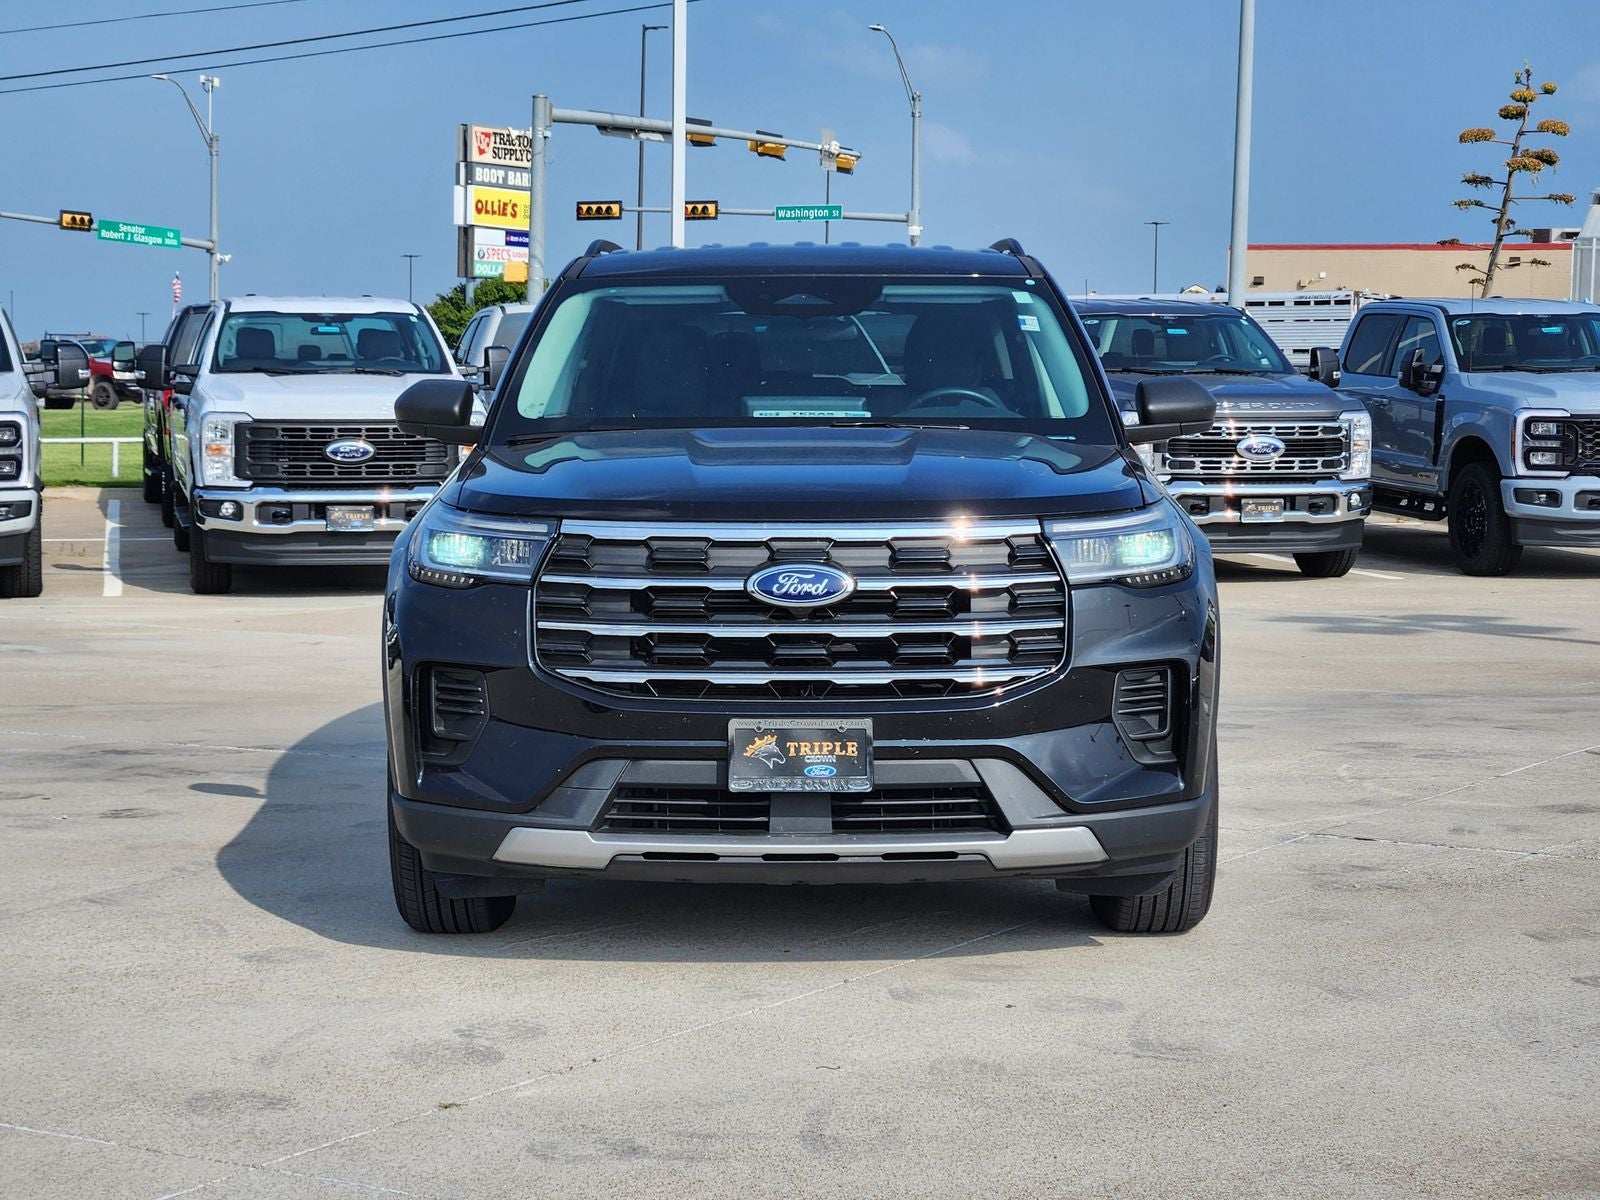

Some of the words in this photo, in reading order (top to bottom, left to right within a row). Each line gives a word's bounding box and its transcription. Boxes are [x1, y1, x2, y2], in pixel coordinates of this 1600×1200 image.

[492, 132, 532, 148] TRACTO
[492, 146, 525, 162] SUPPLY
[475, 167, 505, 185] BOOT
[777, 209, 829, 219] Washington
[118, 223, 146, 234] Senator
[101, 231, 125, 240] Robert
[133, 233, 162, 245] Glasgow
[475, 263, 503, 274] DOLLA
[337, 446, 363, 457] Ford
[772, 572, 829, 596] Ford
[786, 741, 858, 757] TRIPLE
[804, 755, 836, 763] CROWN
[809, 766, 830, 776] Ford
